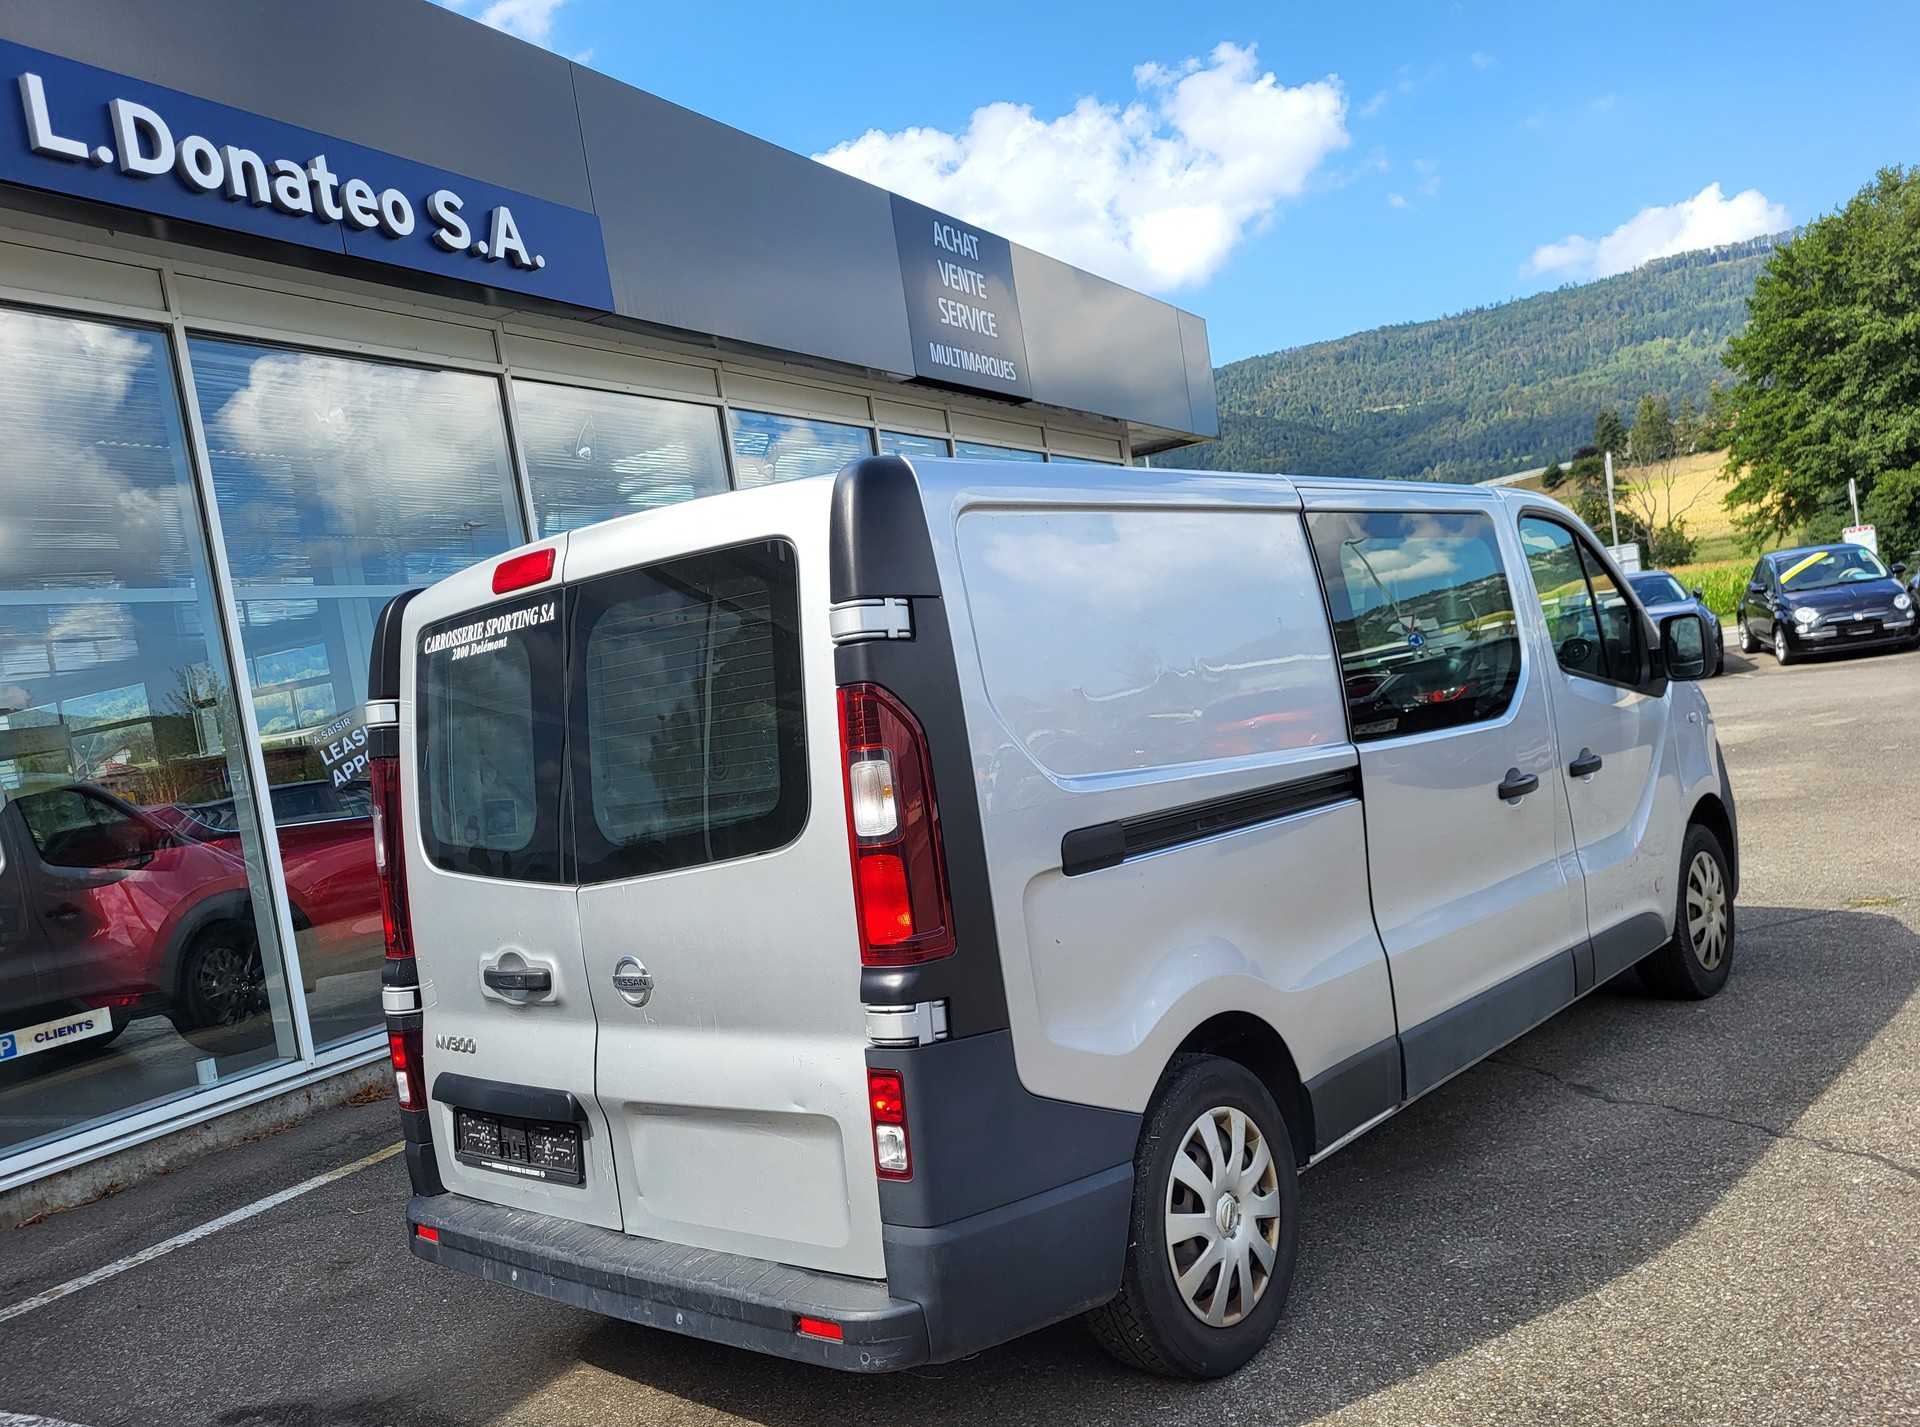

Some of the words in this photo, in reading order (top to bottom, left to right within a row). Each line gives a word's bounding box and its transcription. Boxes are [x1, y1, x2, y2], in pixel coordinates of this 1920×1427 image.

[426, 189, 547, 271] S.A.
[933, 221, 979, 261] ACHAT
[937, 259, 988, 299] VENTE
[938, 297, 999, 338] SERVICE
[929, 342, 1017, 381] MULTIMARQUES
[424, 621, 485, 655] CARROSSERIE
[485, 606, 539, 637] SPORTING
[540, 602, 556, 624] SA
[451, 646, 470, 661] 2800
[470, 636, 508, 656] Delémont
[614, 978, 647, 987] NISSAN
[34, 1020, 94, 1043] CLIENTS
[435, 1034, 477, 1055] NV300
